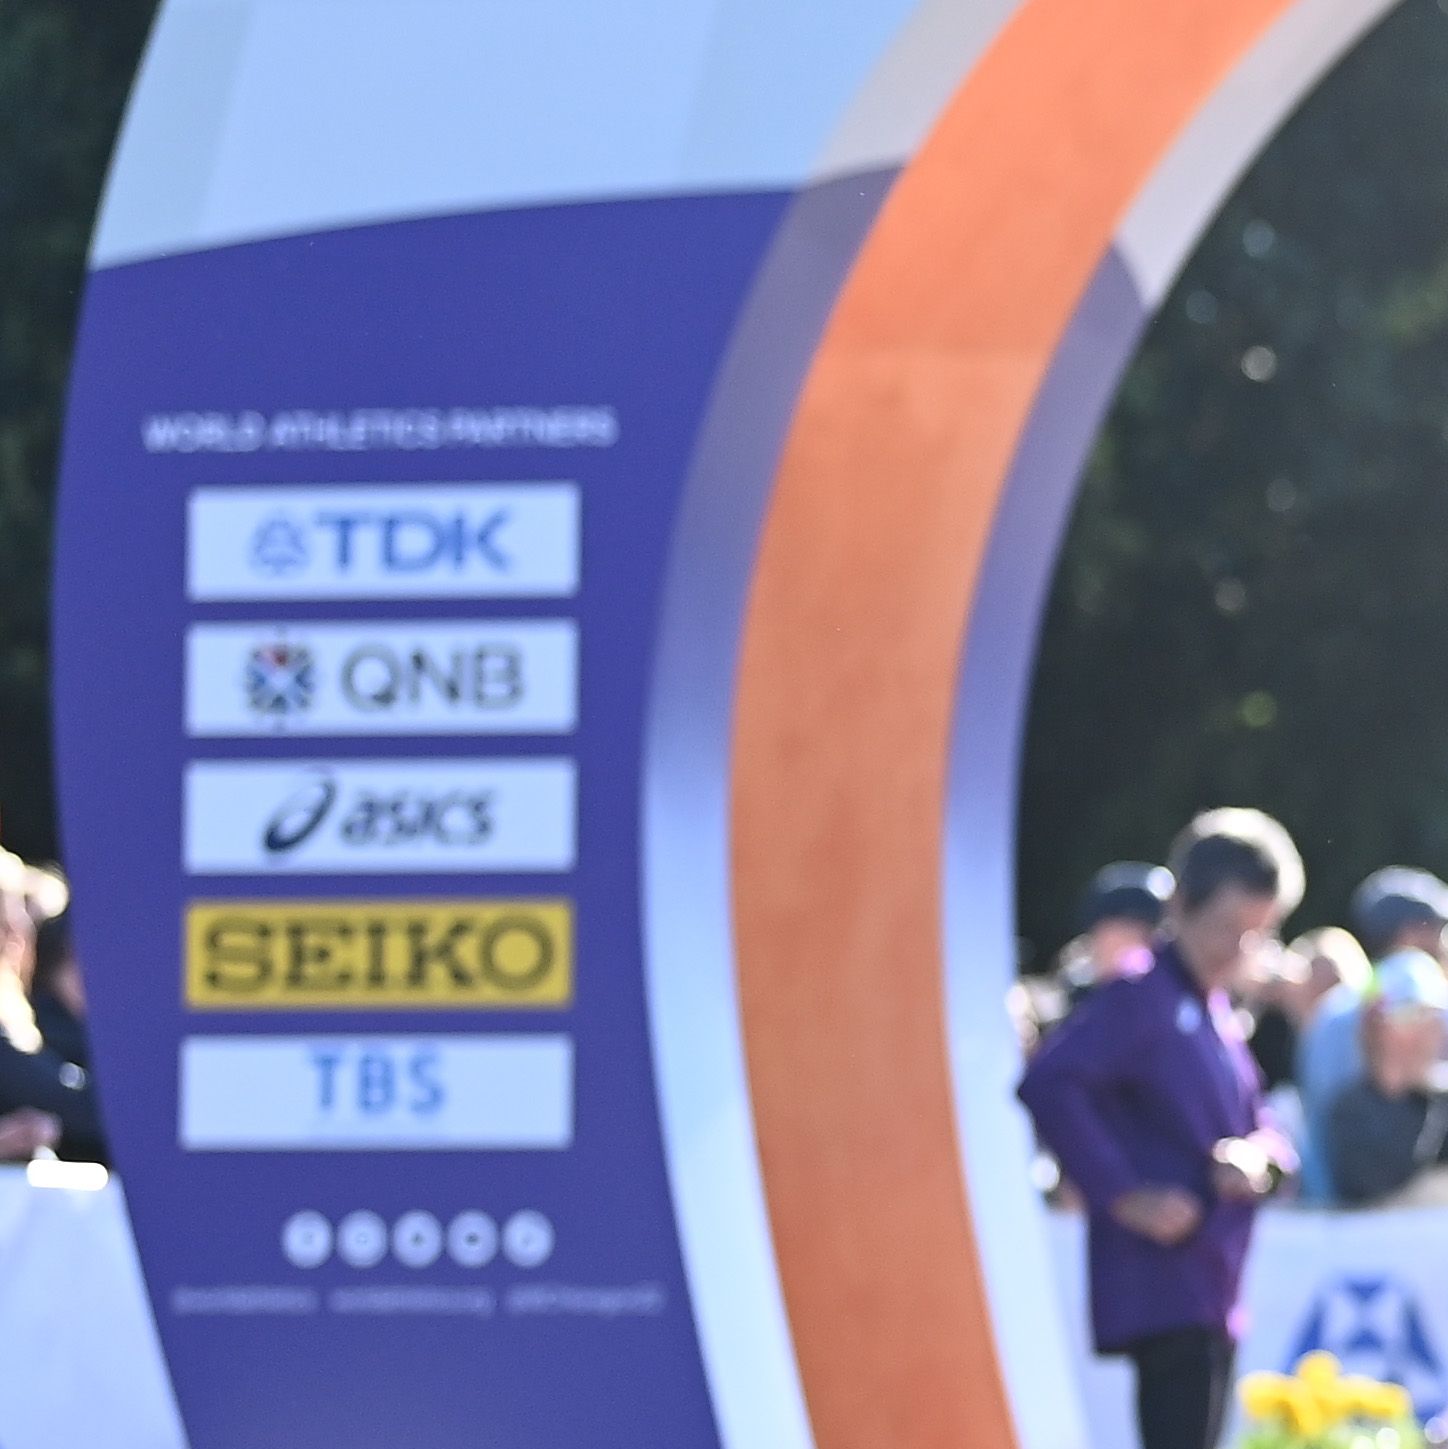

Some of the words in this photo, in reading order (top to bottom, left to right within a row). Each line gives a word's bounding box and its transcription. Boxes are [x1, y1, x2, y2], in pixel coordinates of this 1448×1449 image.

[316, 510, 515, 574] TDK
[341, 643, 524, 710] QNB
[203, 914, 556, 994] SEIKO
[307, 1049, 448, 1116] TBS
